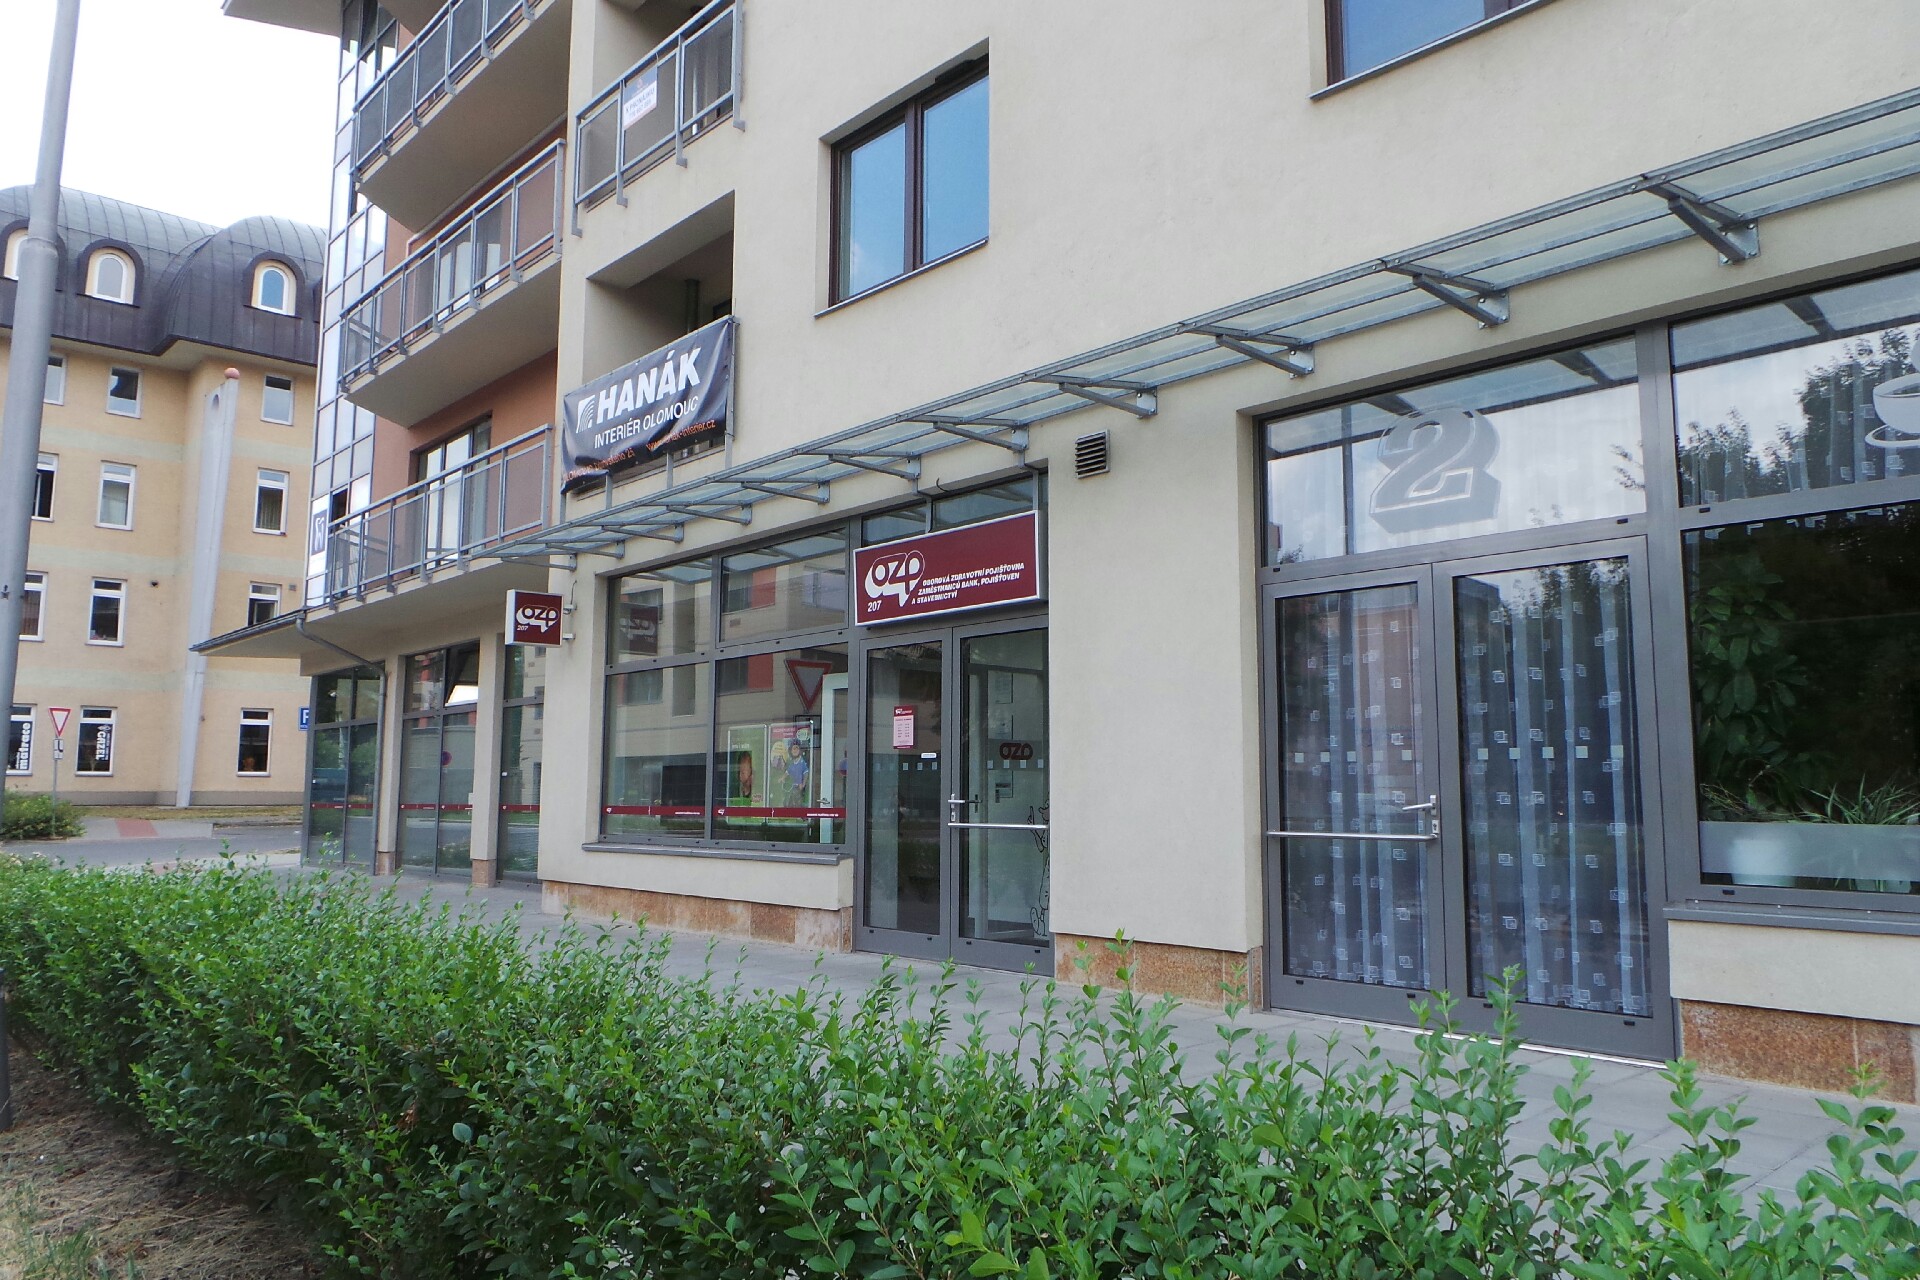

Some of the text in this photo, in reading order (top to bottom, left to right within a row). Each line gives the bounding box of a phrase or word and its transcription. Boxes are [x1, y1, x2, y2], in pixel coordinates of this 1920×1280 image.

[596, 347, 701, 425] HANÁK
[594, 395, 699, 449] INTERIÉR OLOMOUC
[917, 582, 961, 596] ZAMĚSTNANCŮ
[981, 572, 1020, 586] POJIŠŤOVEN
[922, 562, 1025, 587] OBOROVÁ ZDRAVOTNÍ POJIŠŤOVNA
[867, 600, 882, 613] 207
[911, 590, 958, 605] A STAVEBNICTVÍ
